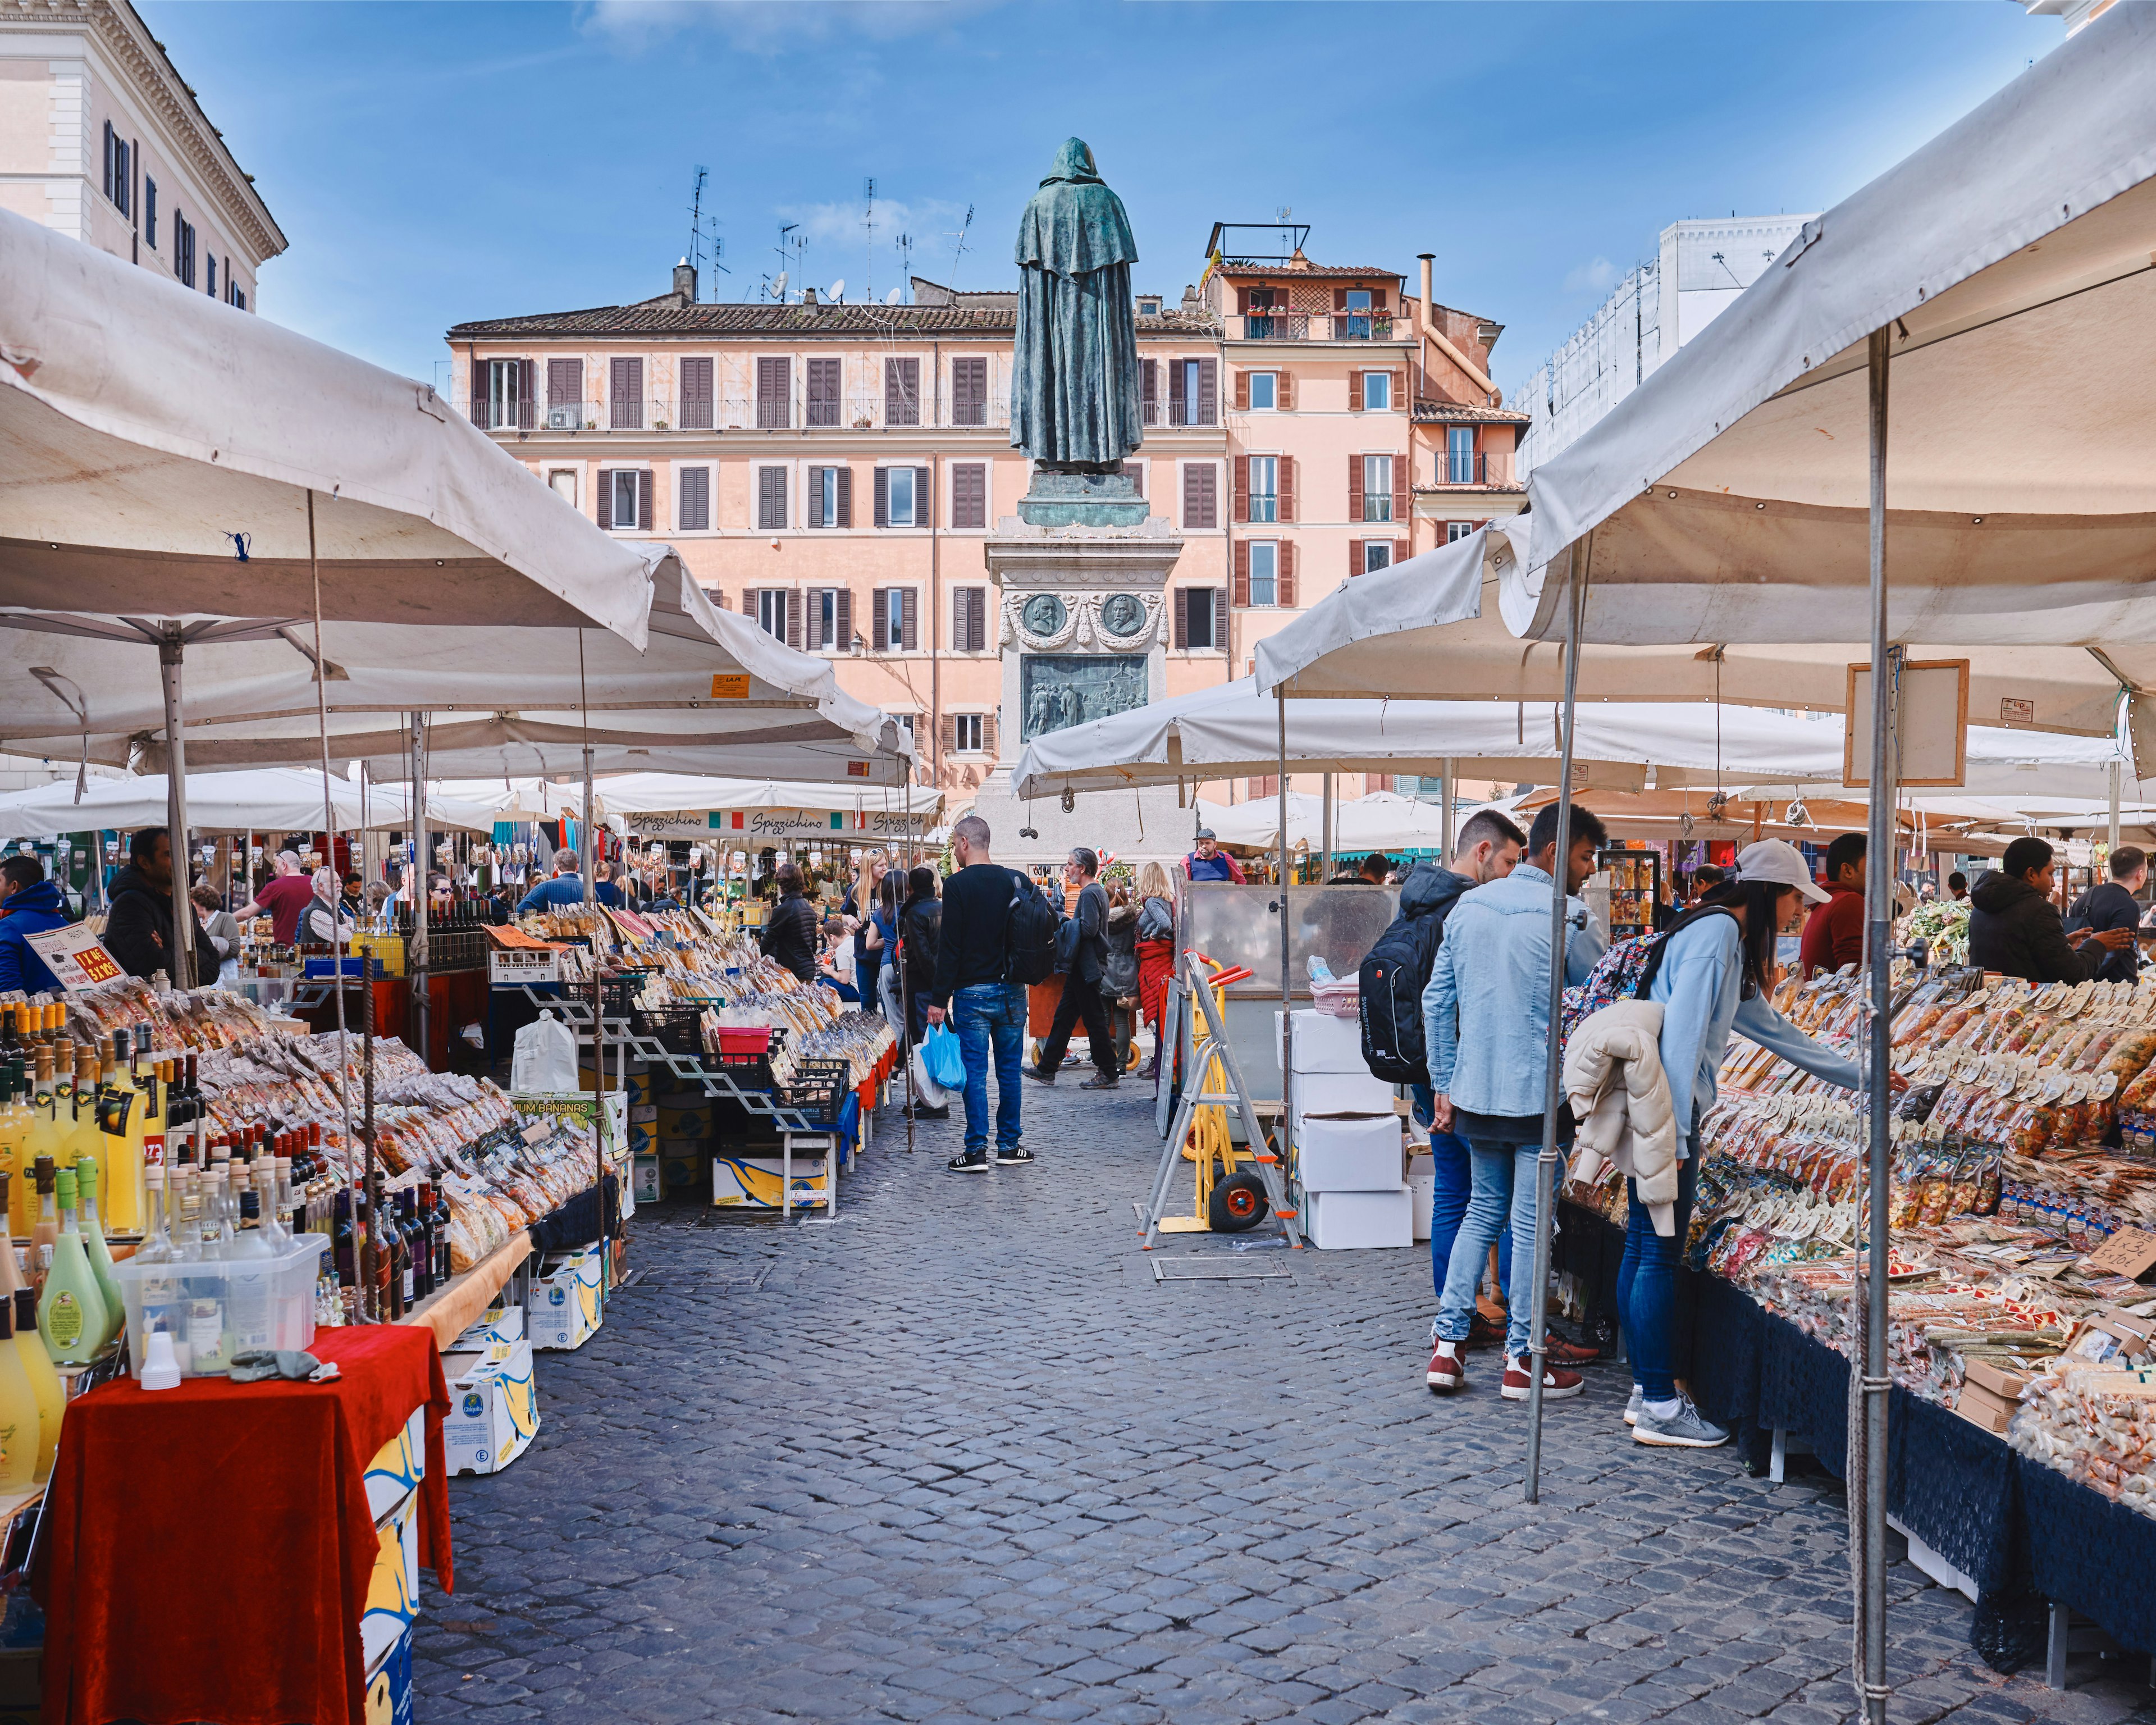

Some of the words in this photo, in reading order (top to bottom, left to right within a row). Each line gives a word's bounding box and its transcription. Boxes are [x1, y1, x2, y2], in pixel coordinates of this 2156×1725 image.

[631, 810, 702, 831] Spizzichino
[751, 813, 823, 835] Spizzichino
[67, 929, 86, 940] PASTA
[1362, 996, 1374, 1055] SWISSTRAVEL
[538, 1103, 588, 1112] BANANAS
